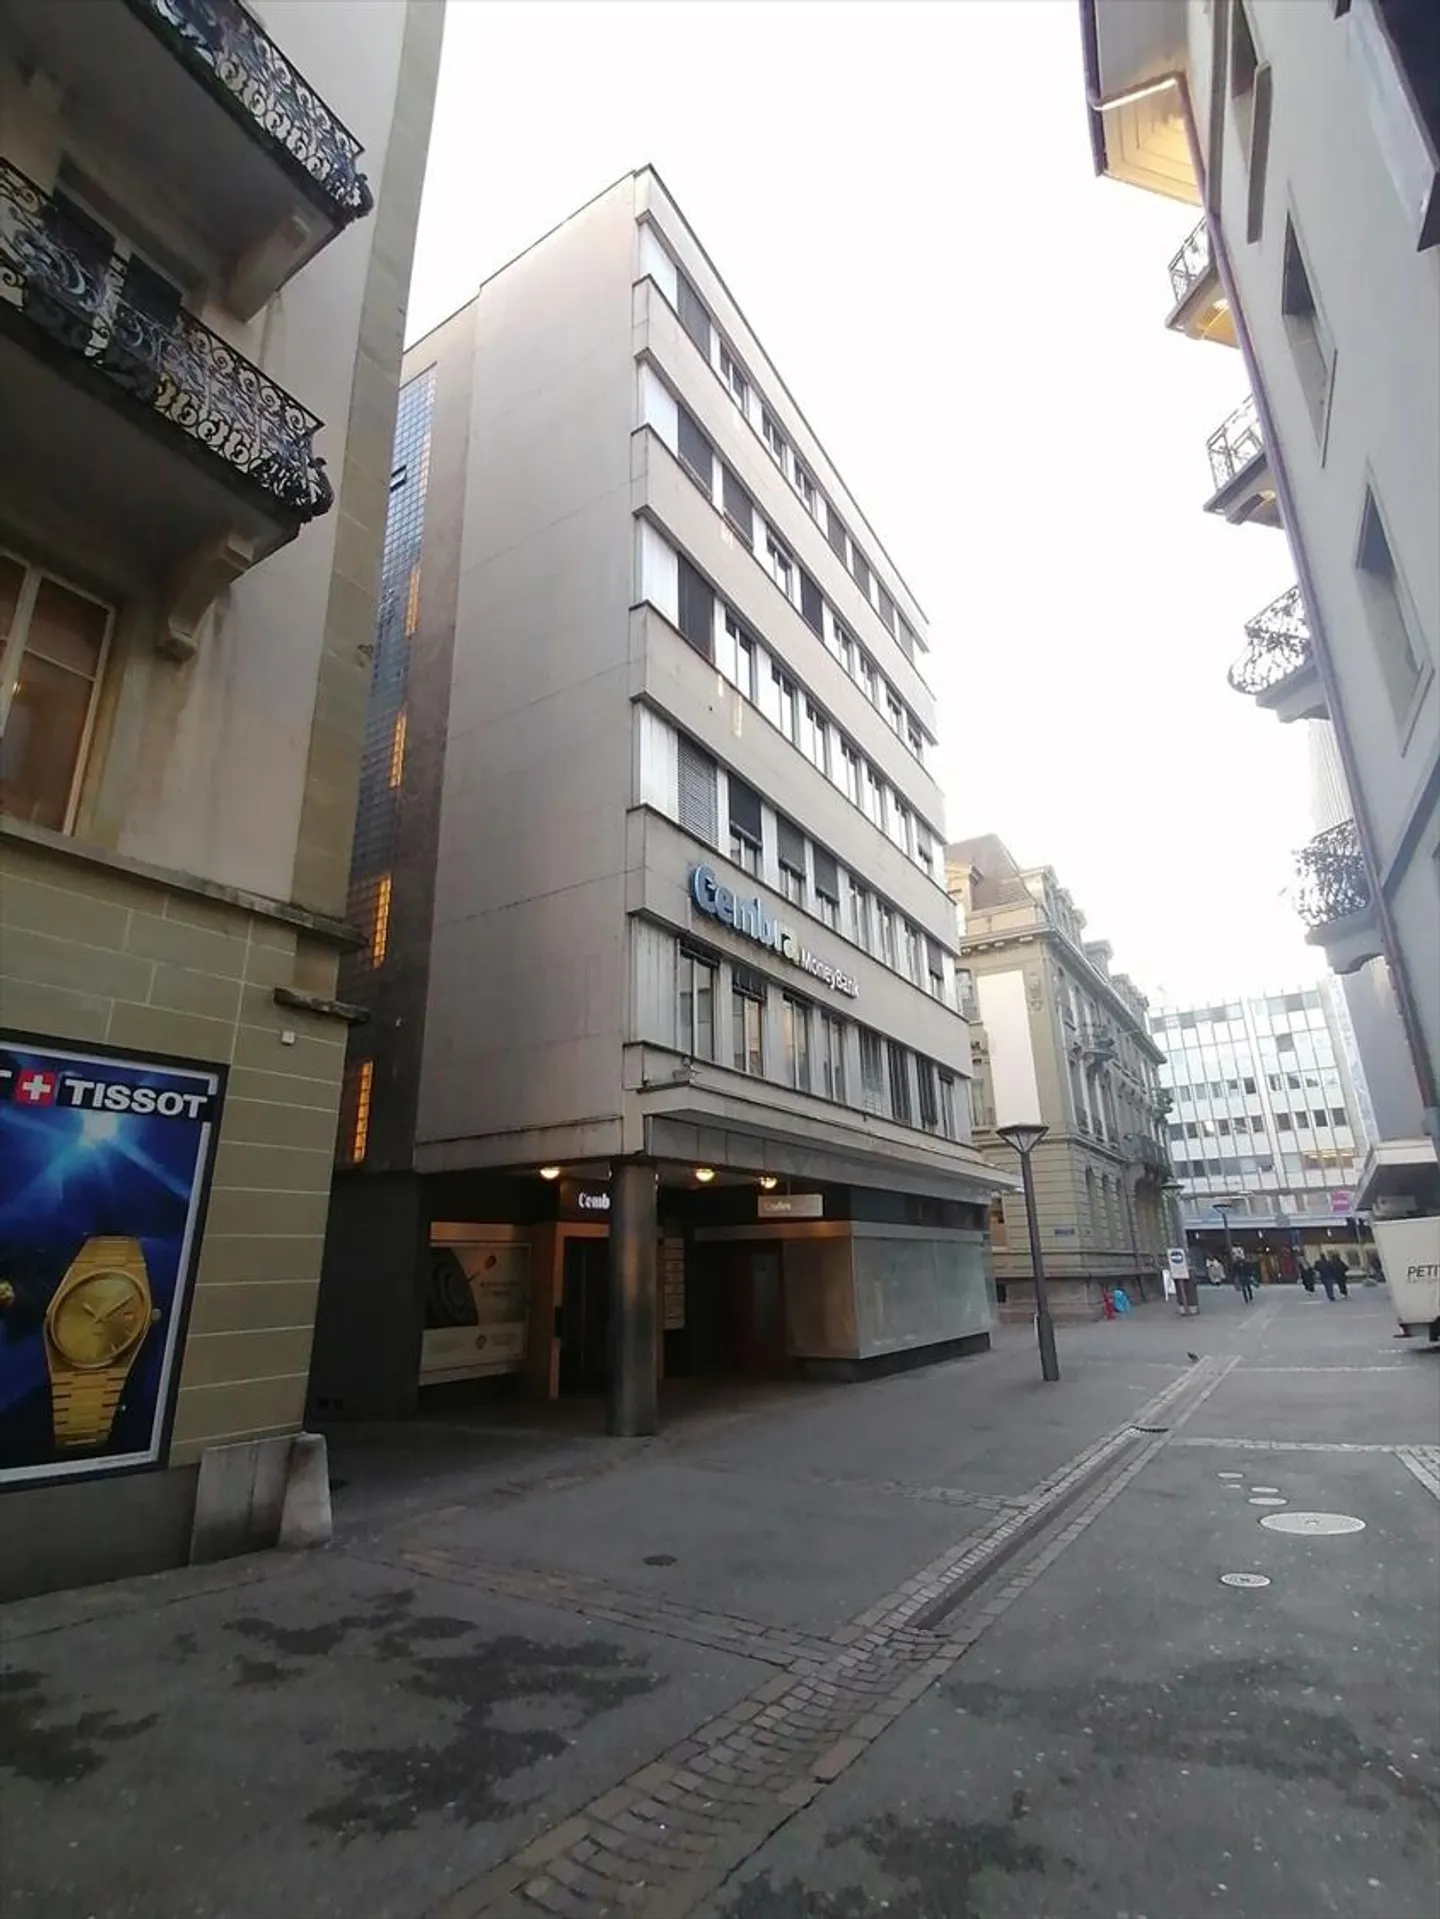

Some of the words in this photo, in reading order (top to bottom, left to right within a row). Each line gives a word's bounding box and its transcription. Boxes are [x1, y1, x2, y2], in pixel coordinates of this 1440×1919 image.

[691, 862, 800, 966] Cembra
[65, 1078, 208, 1119] TISSOT
[1407, 1264, 1440, 1278] PETI
